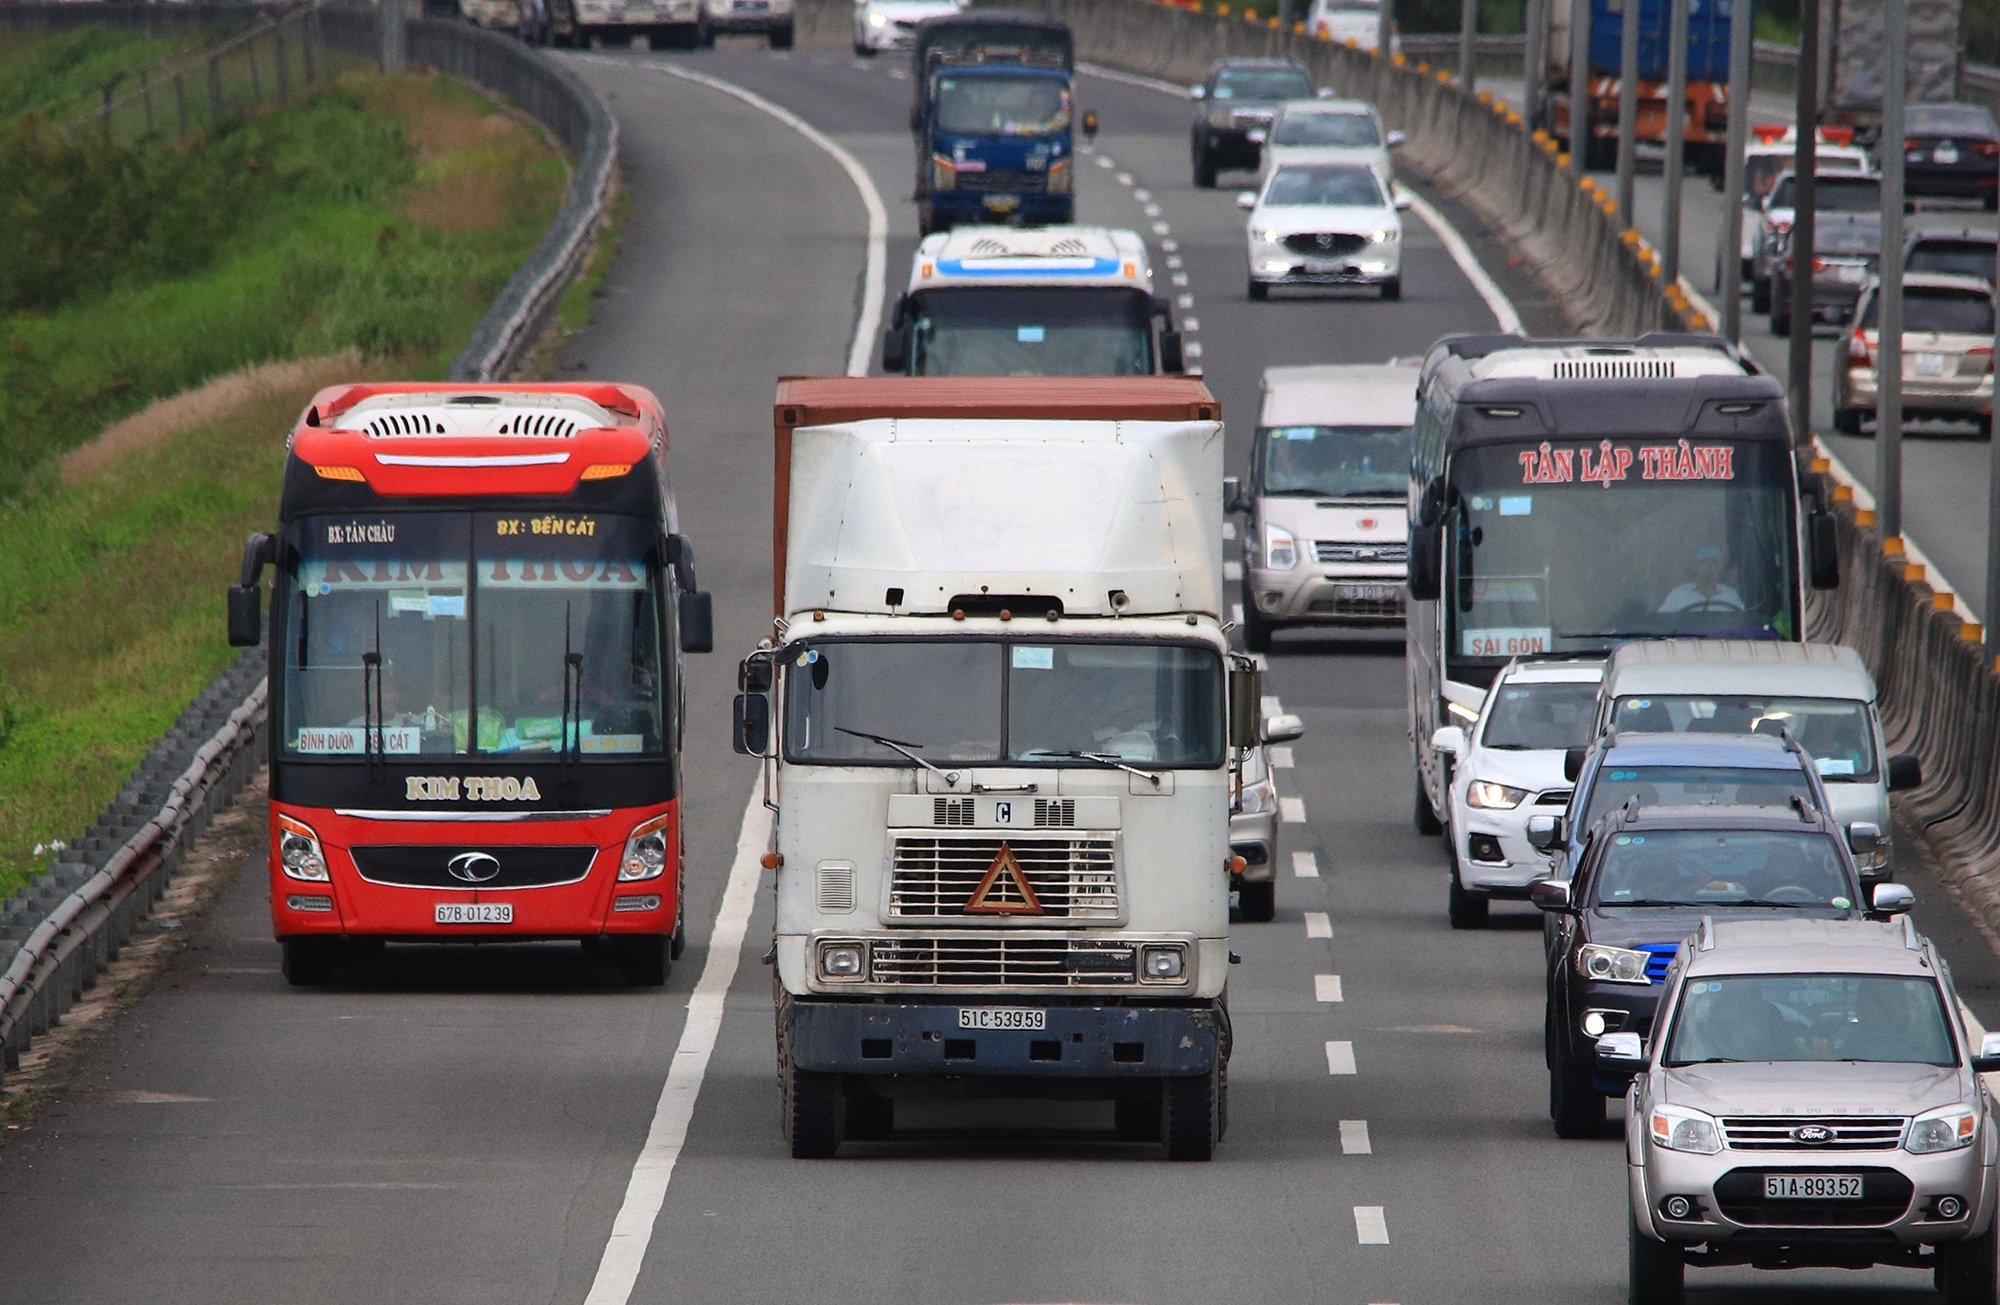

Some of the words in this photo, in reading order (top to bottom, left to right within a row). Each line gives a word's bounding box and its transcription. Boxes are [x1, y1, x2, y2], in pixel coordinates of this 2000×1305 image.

[1518, 441, 1574, 483] TÂN
[1579, 439, 1633, 489] LẬP
[1638, 438, 1735, 480] THÀNH
[1471, 634, 1501, 656] SÀI
[1507, 633, 1544, 654] GÒN
[405, 776, 461, 801] KIM
[463, 776, 542, 801] THOA
[960, 1010, 1044, 1028] 51C-539.59
[1800, 1127, 1827, 1140] Ford
[1766, 1177, 1860, 1196] 51A-893.52
